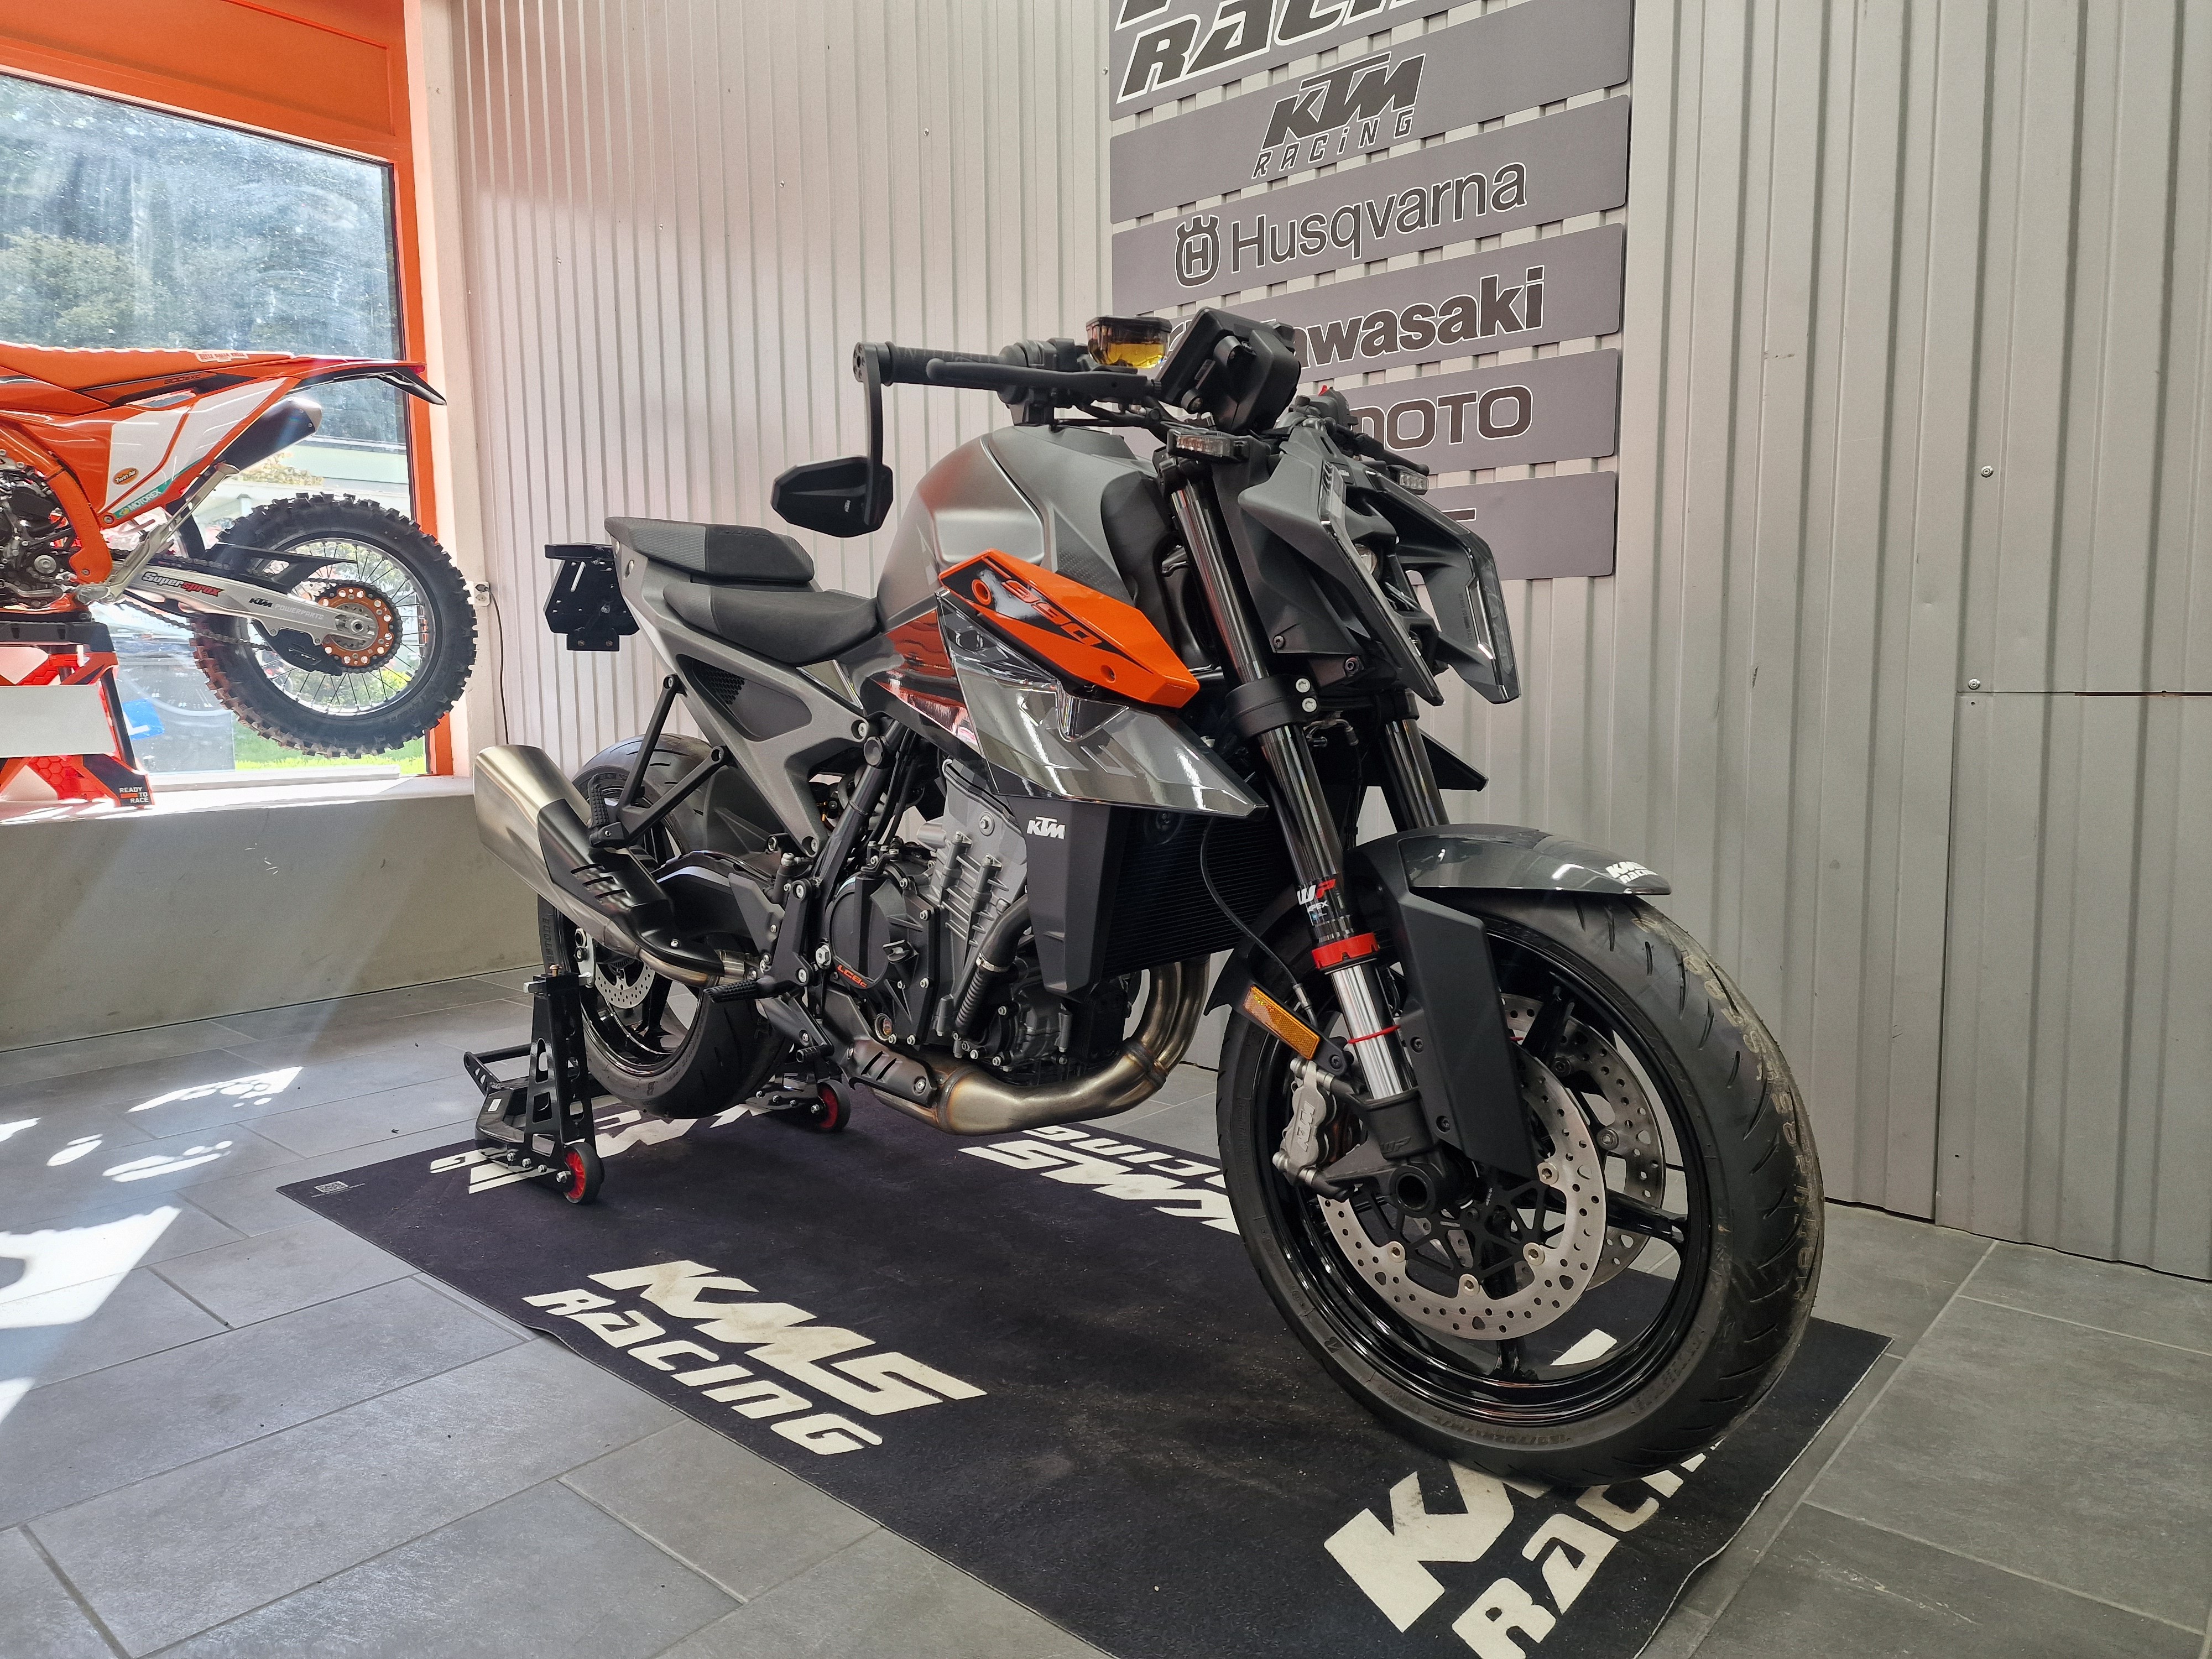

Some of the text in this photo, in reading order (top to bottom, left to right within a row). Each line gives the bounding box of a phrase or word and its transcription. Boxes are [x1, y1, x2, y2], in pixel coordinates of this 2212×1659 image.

[1261, 51, 1426, 150] KTM
[1230, 161, 1527, 260] Husqvarna
[1292, 265, 1545, 369] wasaki
[114, 469, 137, 484] Twin Air
[127, 488, 162, 511] MOTOREX
[142, 571, 226, 597] Supersprox
[249, 597, 324, 620] KTM POWERPARTS
[1026, 816, 1066, 840] KTM
[1297, 878, 1336, 905] WP
[1307, 900, 1329, 914] APEX
[1021, 1125, 1227, 1189] CING
[587, 1259, 988, 1416] KMS
